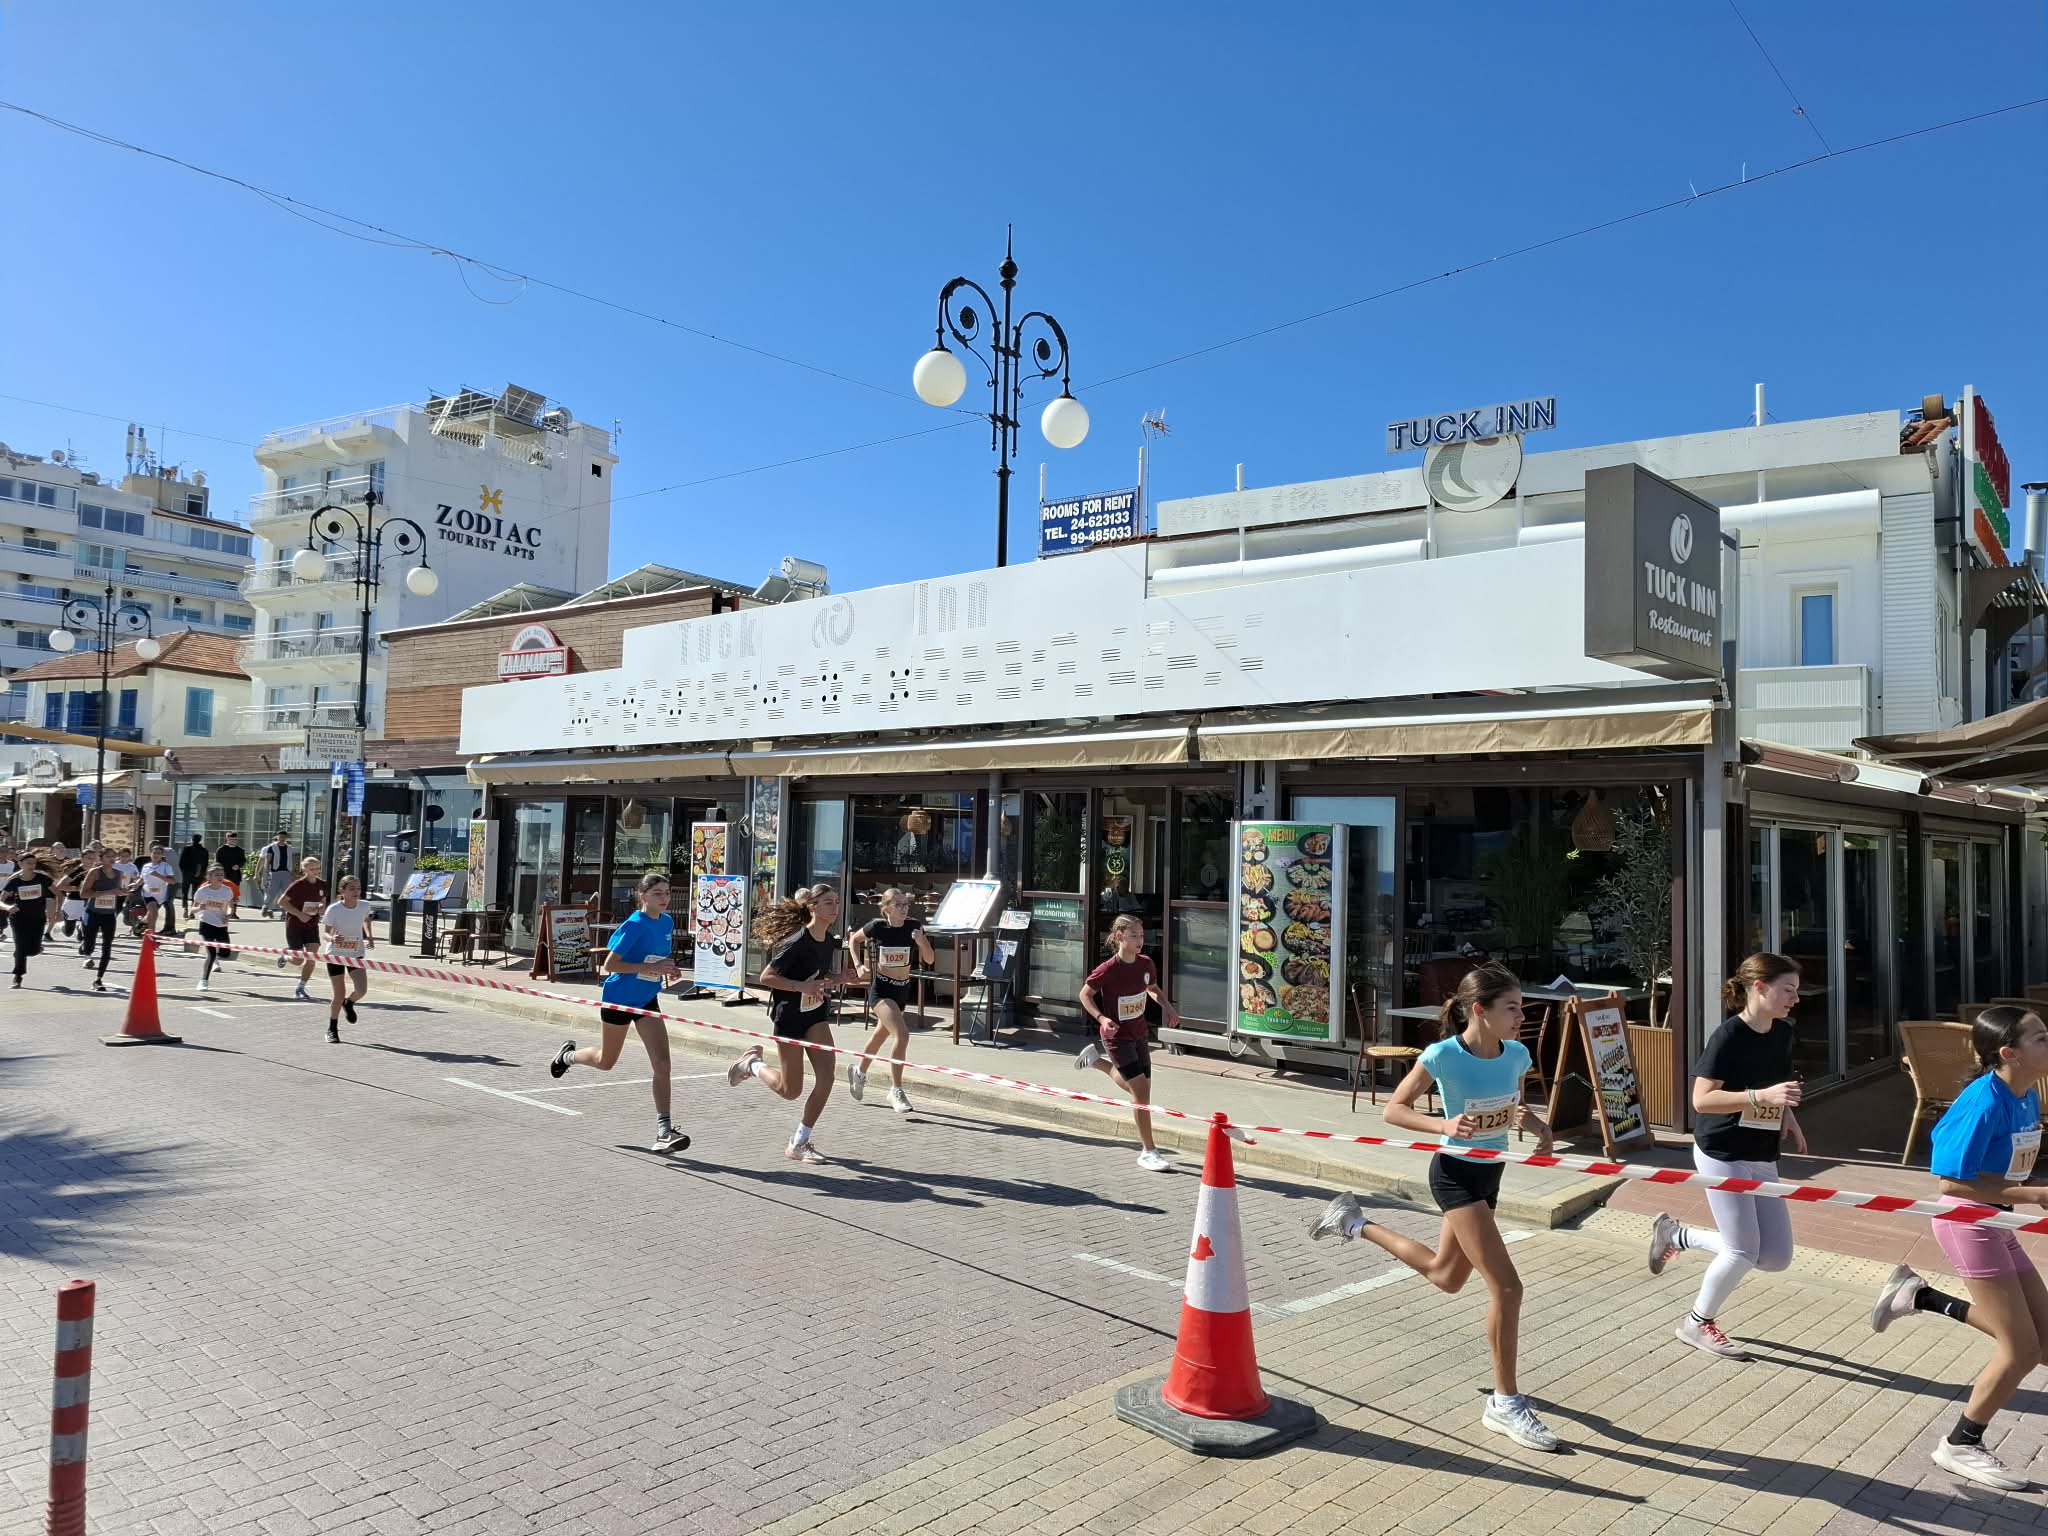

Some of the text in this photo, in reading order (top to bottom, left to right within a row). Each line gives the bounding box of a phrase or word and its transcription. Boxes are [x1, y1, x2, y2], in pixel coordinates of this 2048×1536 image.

[1388, 399, 1555, 449] TUCK INN
[1043, 494, 1132, 520] ROOMS FOR RENT
[436, 504, 542, 547] ZODIAC
[1071, 511, 1130, 530] 24-623133
[1045, 527, 1068, 540] TEL.
[1070, 526, 1131, 544] 99-485033
[439, 528, 535, 560] TOURIST APTS
[1644, 561, 1717, 618] TUCK INN
[1649, 609, 1713, 647] Restaurant
[1268, 829, 1296, 843] MENU
[1046, 901, 1062, 909] FULLY
[886, 954, 904, 962] 1029
[1476, 1109, 1509, 1129] 1223
[1753, 1106, 1780, 1119] 1252
